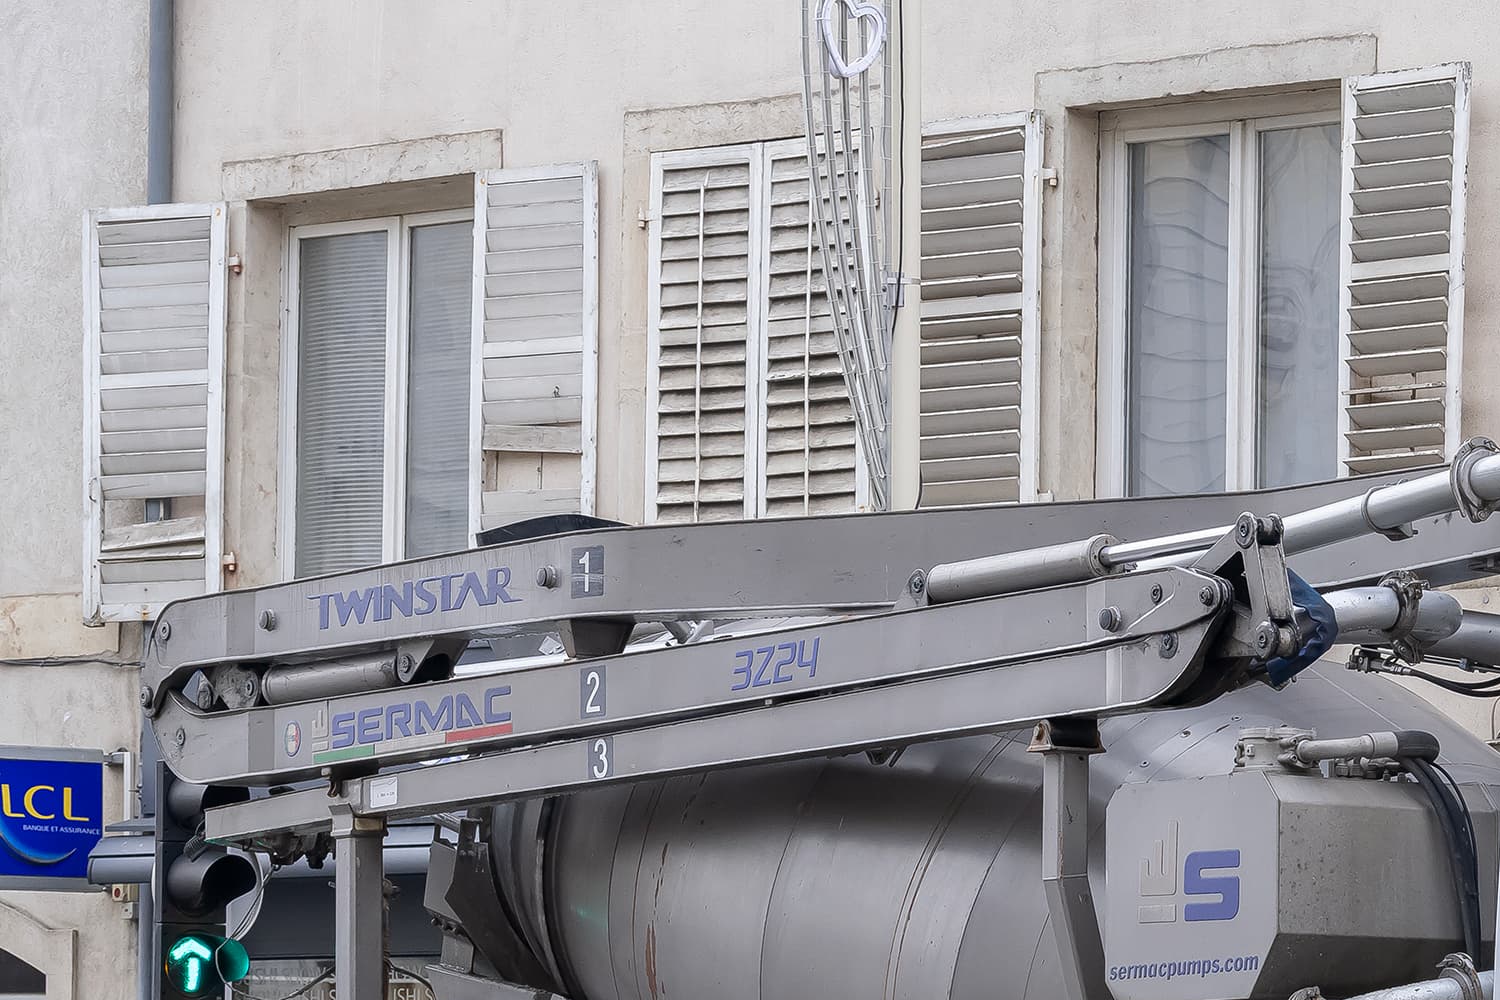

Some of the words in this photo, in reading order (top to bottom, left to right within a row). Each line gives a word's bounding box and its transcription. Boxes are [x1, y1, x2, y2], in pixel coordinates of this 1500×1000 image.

[578, 551, 590, 593] 1
[306, 566, 522, 630] TWINSTAR
[731, 636, 820, 691] 3Z24
[584, 671, 601, 713] 2
[332, 685, 512, 750] SERMAC
[592, 738, 608, 779] 3
[1, 783, 90, 822] LCL
[23, 824, 50, 832] BANQUE
[59, 826, 101, 835] ASSURANCE
[1109, 954, 1259, 981] sermacpumps.com
